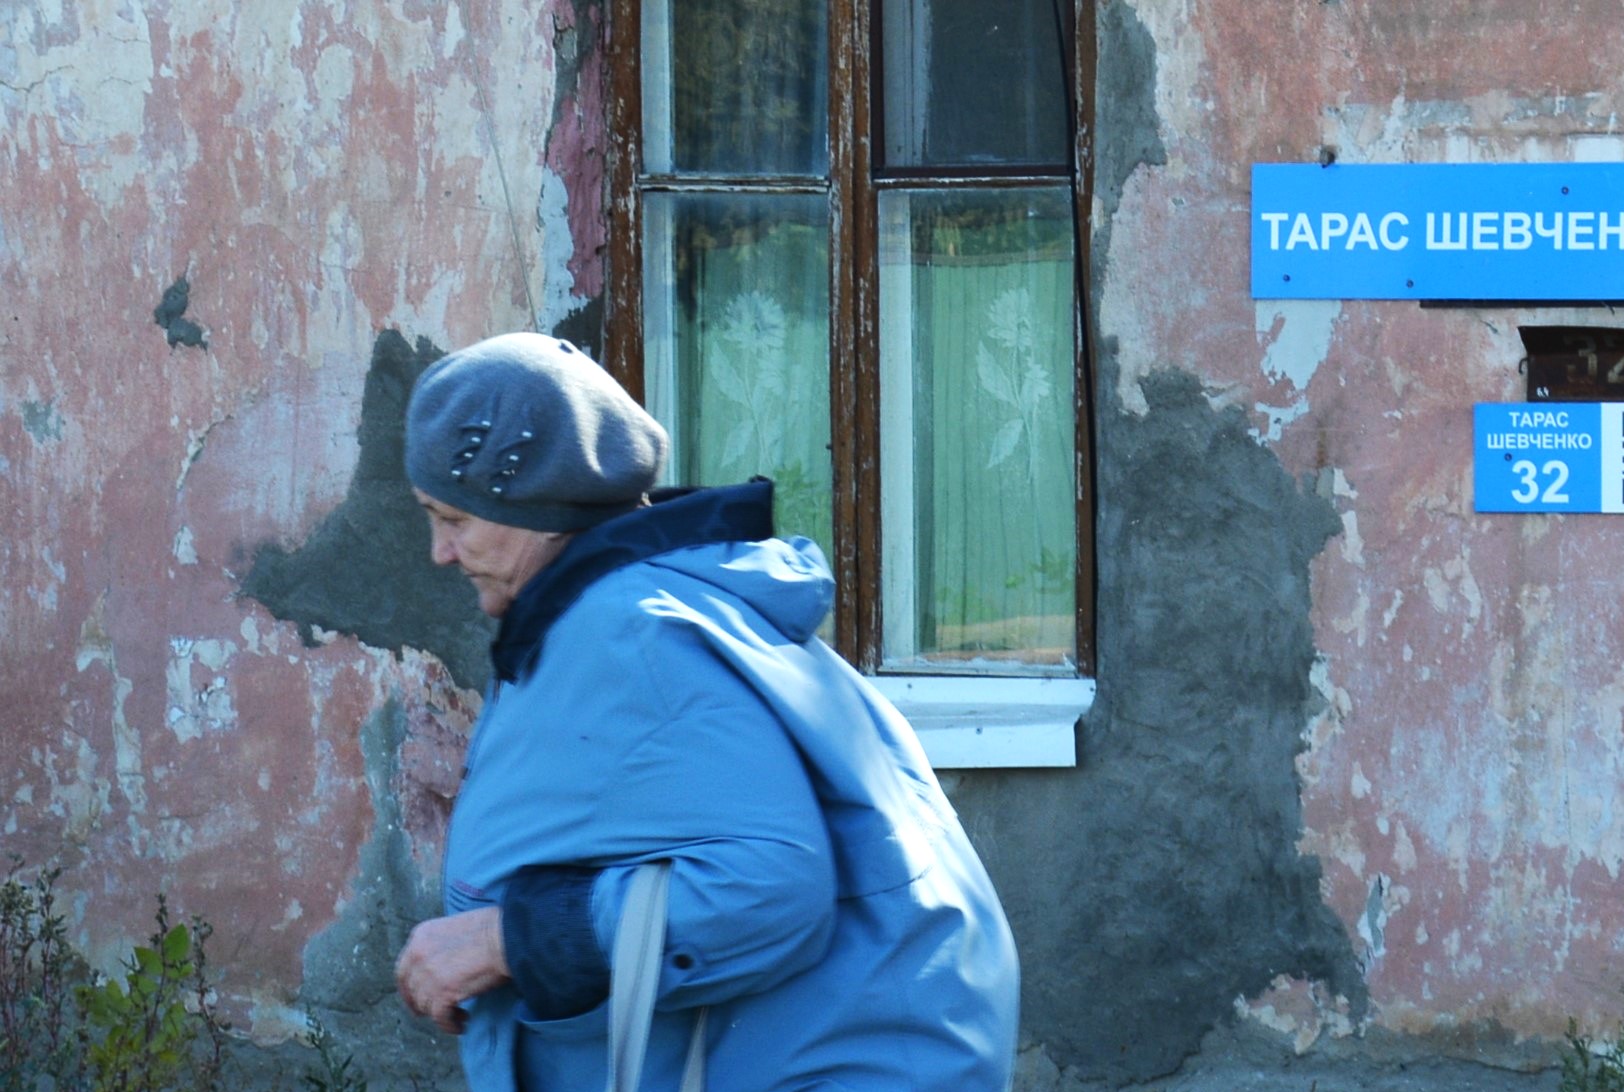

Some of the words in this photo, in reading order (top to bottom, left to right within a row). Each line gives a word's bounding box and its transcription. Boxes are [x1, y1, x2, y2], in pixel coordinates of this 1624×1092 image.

[1261, 212, 1410, 251] ТАРАС
[1508, 411, 1569, 428] ТАРАС
[1487, 432, 1593, 450] ШЕВЧЕНКО
[1510, 459, 1570, 504] 32
